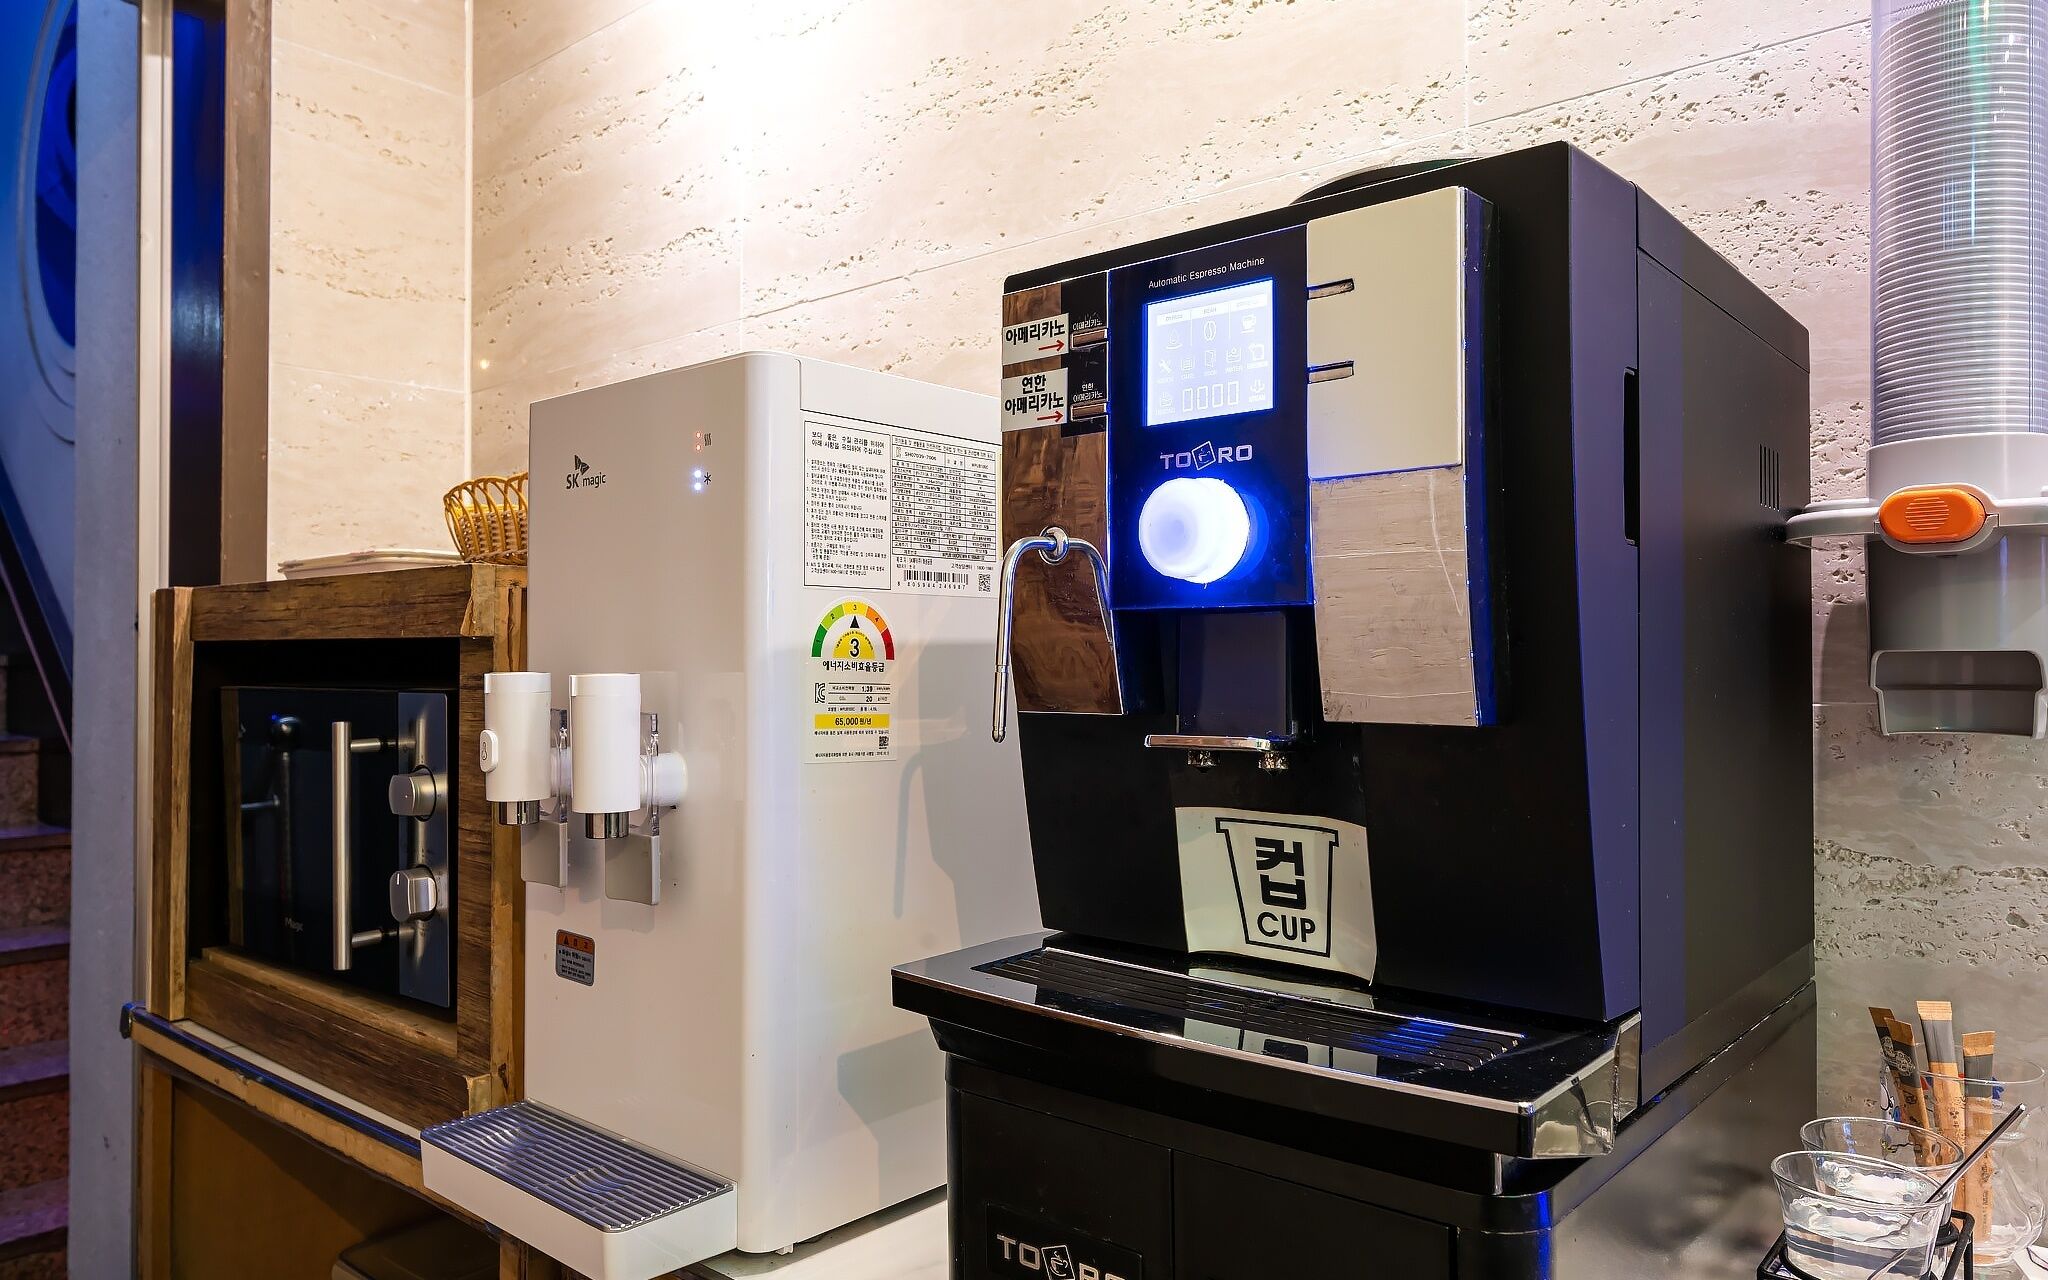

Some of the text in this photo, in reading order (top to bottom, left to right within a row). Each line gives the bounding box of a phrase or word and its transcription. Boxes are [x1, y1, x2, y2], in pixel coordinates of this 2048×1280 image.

[1148, 256, 1265, 289] Automatic Espresso Machine
[1005, 319, 1066, 345] 아메리카노
[1021, 374, 1047, 395] 연한
[1004, 391, 1065, 416] 아메리카노
[566, 471, 606, 489] SK magic
[850, 638, 859, 657] 3
[822, 660, 885, 672] 에너지소비효율등급
[1254, 836, 1307, 911] 컵
[1257, 911, 1316, 943] CUP
